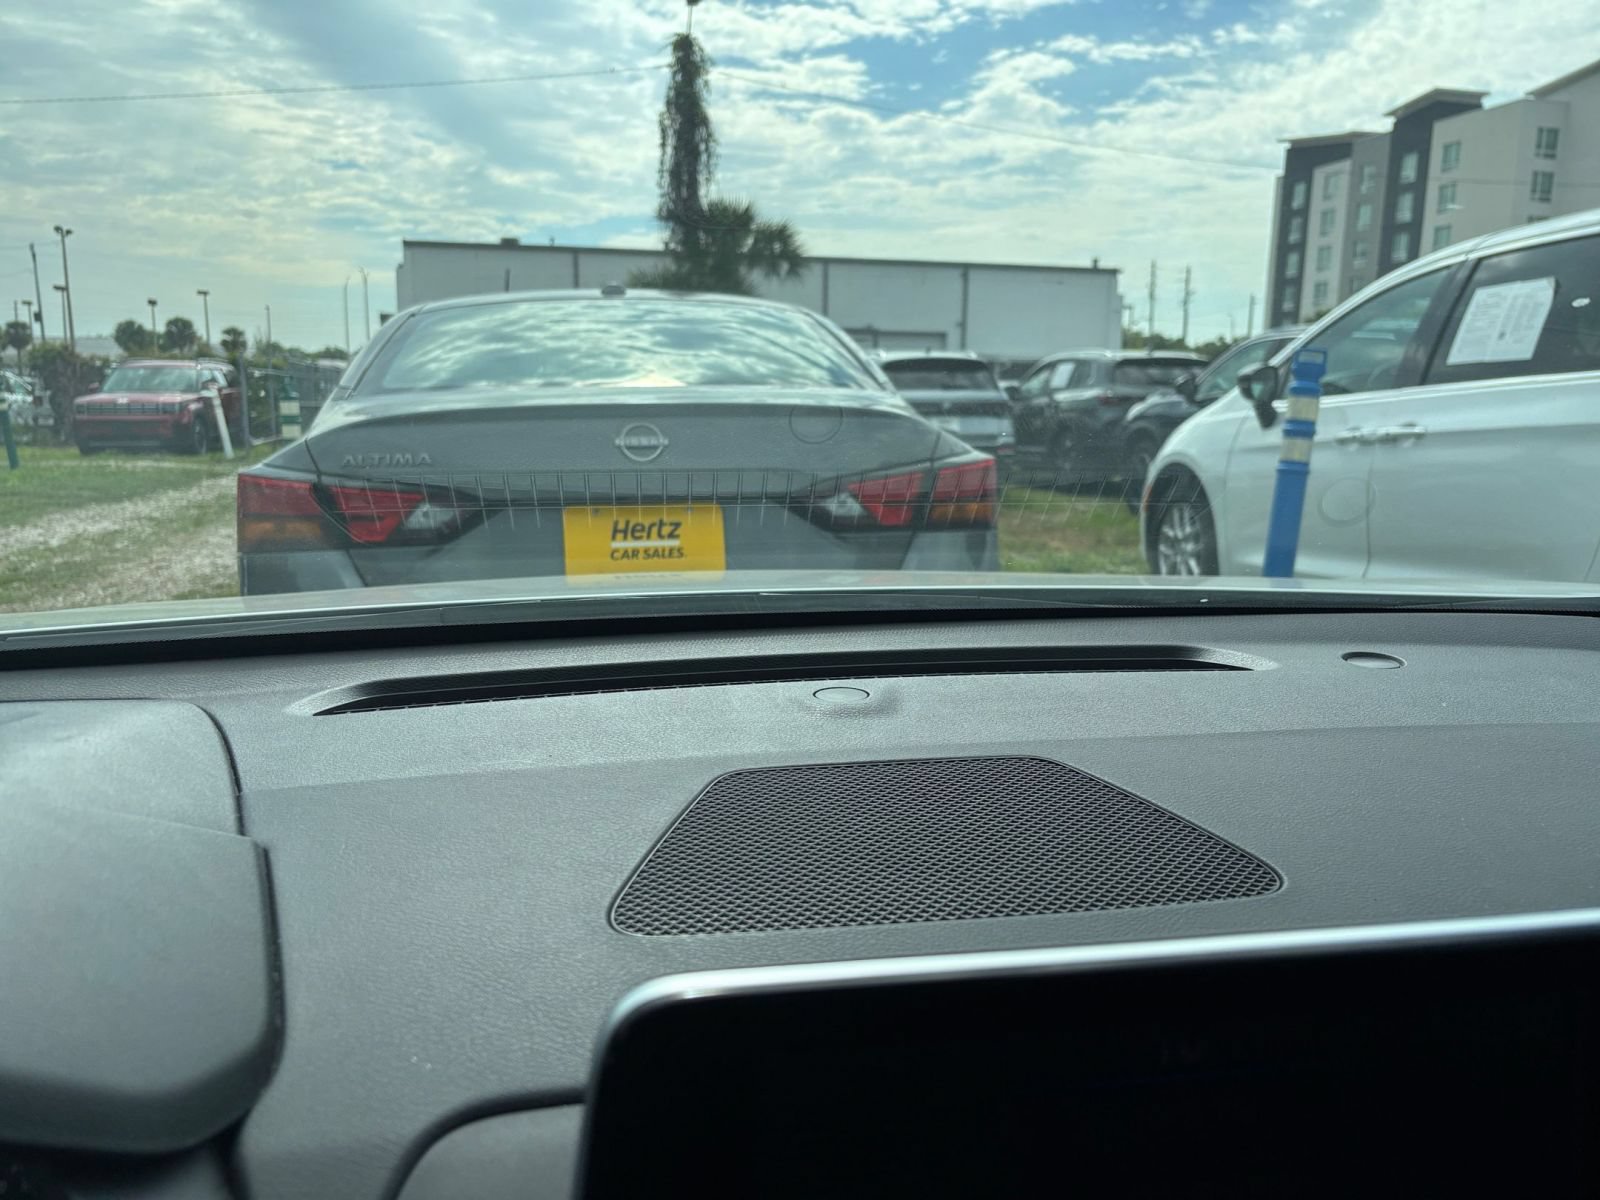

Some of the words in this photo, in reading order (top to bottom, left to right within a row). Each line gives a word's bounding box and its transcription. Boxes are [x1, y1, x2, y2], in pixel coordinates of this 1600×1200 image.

[342, 453, 432, 468] ALTIMA
[611, 518, 682, 541] Hertz
[610, 549, 639, 561] CAR
[643, 547, 684, 560] SALES
